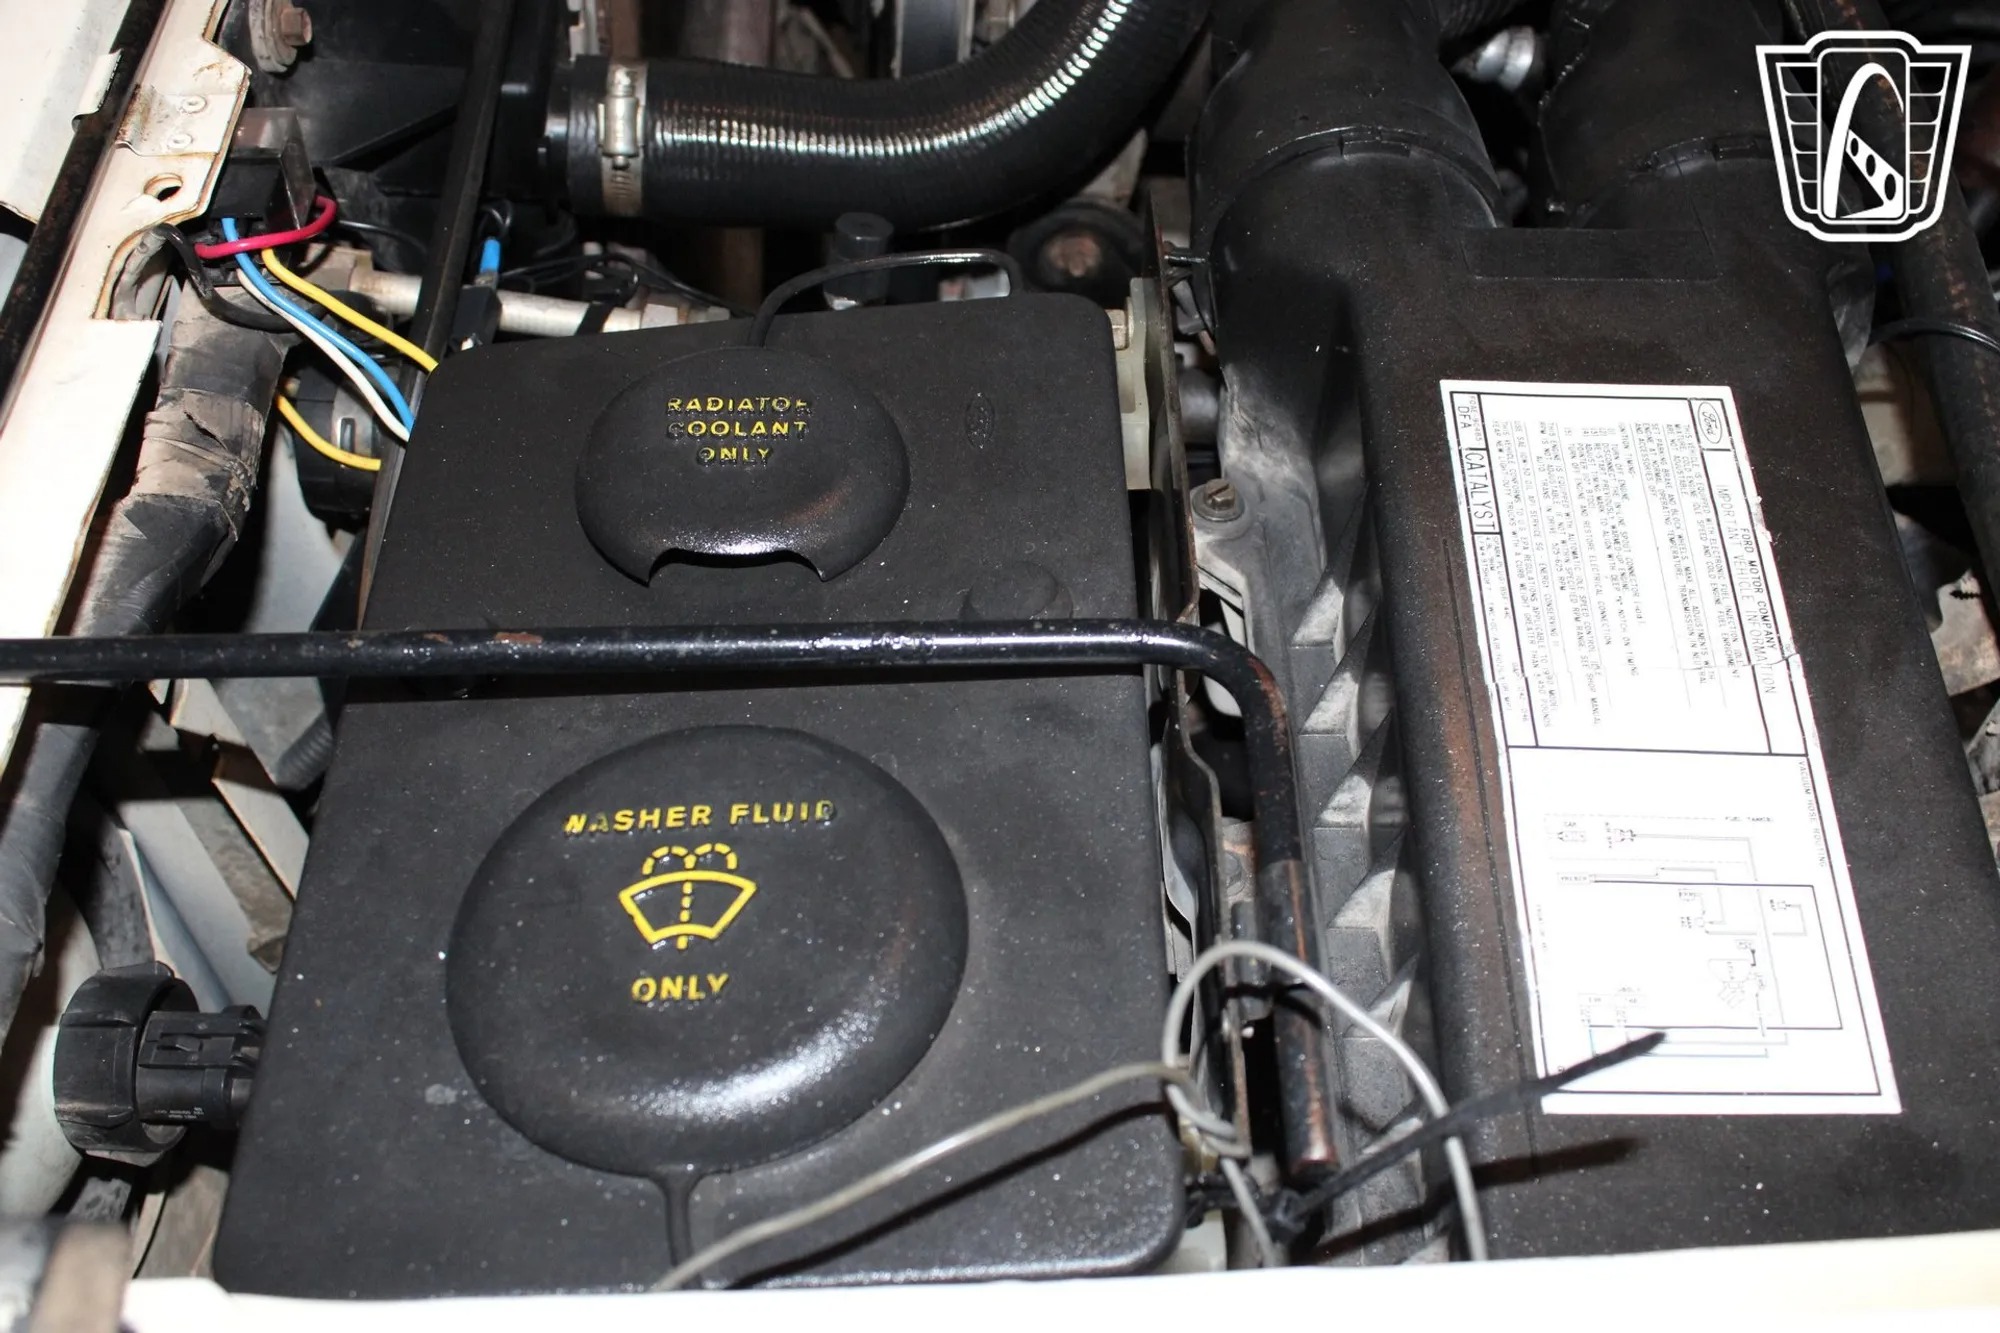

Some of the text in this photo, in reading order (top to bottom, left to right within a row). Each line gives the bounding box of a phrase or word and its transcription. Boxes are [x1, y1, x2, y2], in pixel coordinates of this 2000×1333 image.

[668, 420, 808, 436] COOLANT
[1457, 406, 1472, 429] DFA
[698, 446, 770, 462] ONLY
[1463, 451, 1496, 530] CATALYST
[1686, 442, 1698, 468] VECLE
[1718, 583, 1728, 599] FUEL
[1567, 532, 1580, 570] AUTOMATIC
[1588, 555, 1602, 596] ELECTRICAL
[1624, 557, 1639, 597] CONNECTOR
[1695, 519, 1706, 541] SPEED
[1704, 561, 1715, 578] COLD
[1715, 611, 1726, 627] FUEL
[1714, 484, 1778, 694] IMPORTANT VEHICLE INFORMATION
[1739, 527, 1777, 650] FORD MOTOR COMPANY
[1691, 605, 1708, 655] ADJUSTMENTS
[564, 800, 836, 834] WASHER FLUID
[1797, 760, 1828, 867] VACUUM HOSE ROUTING
[631, 973, 729, 1002] ONLY
